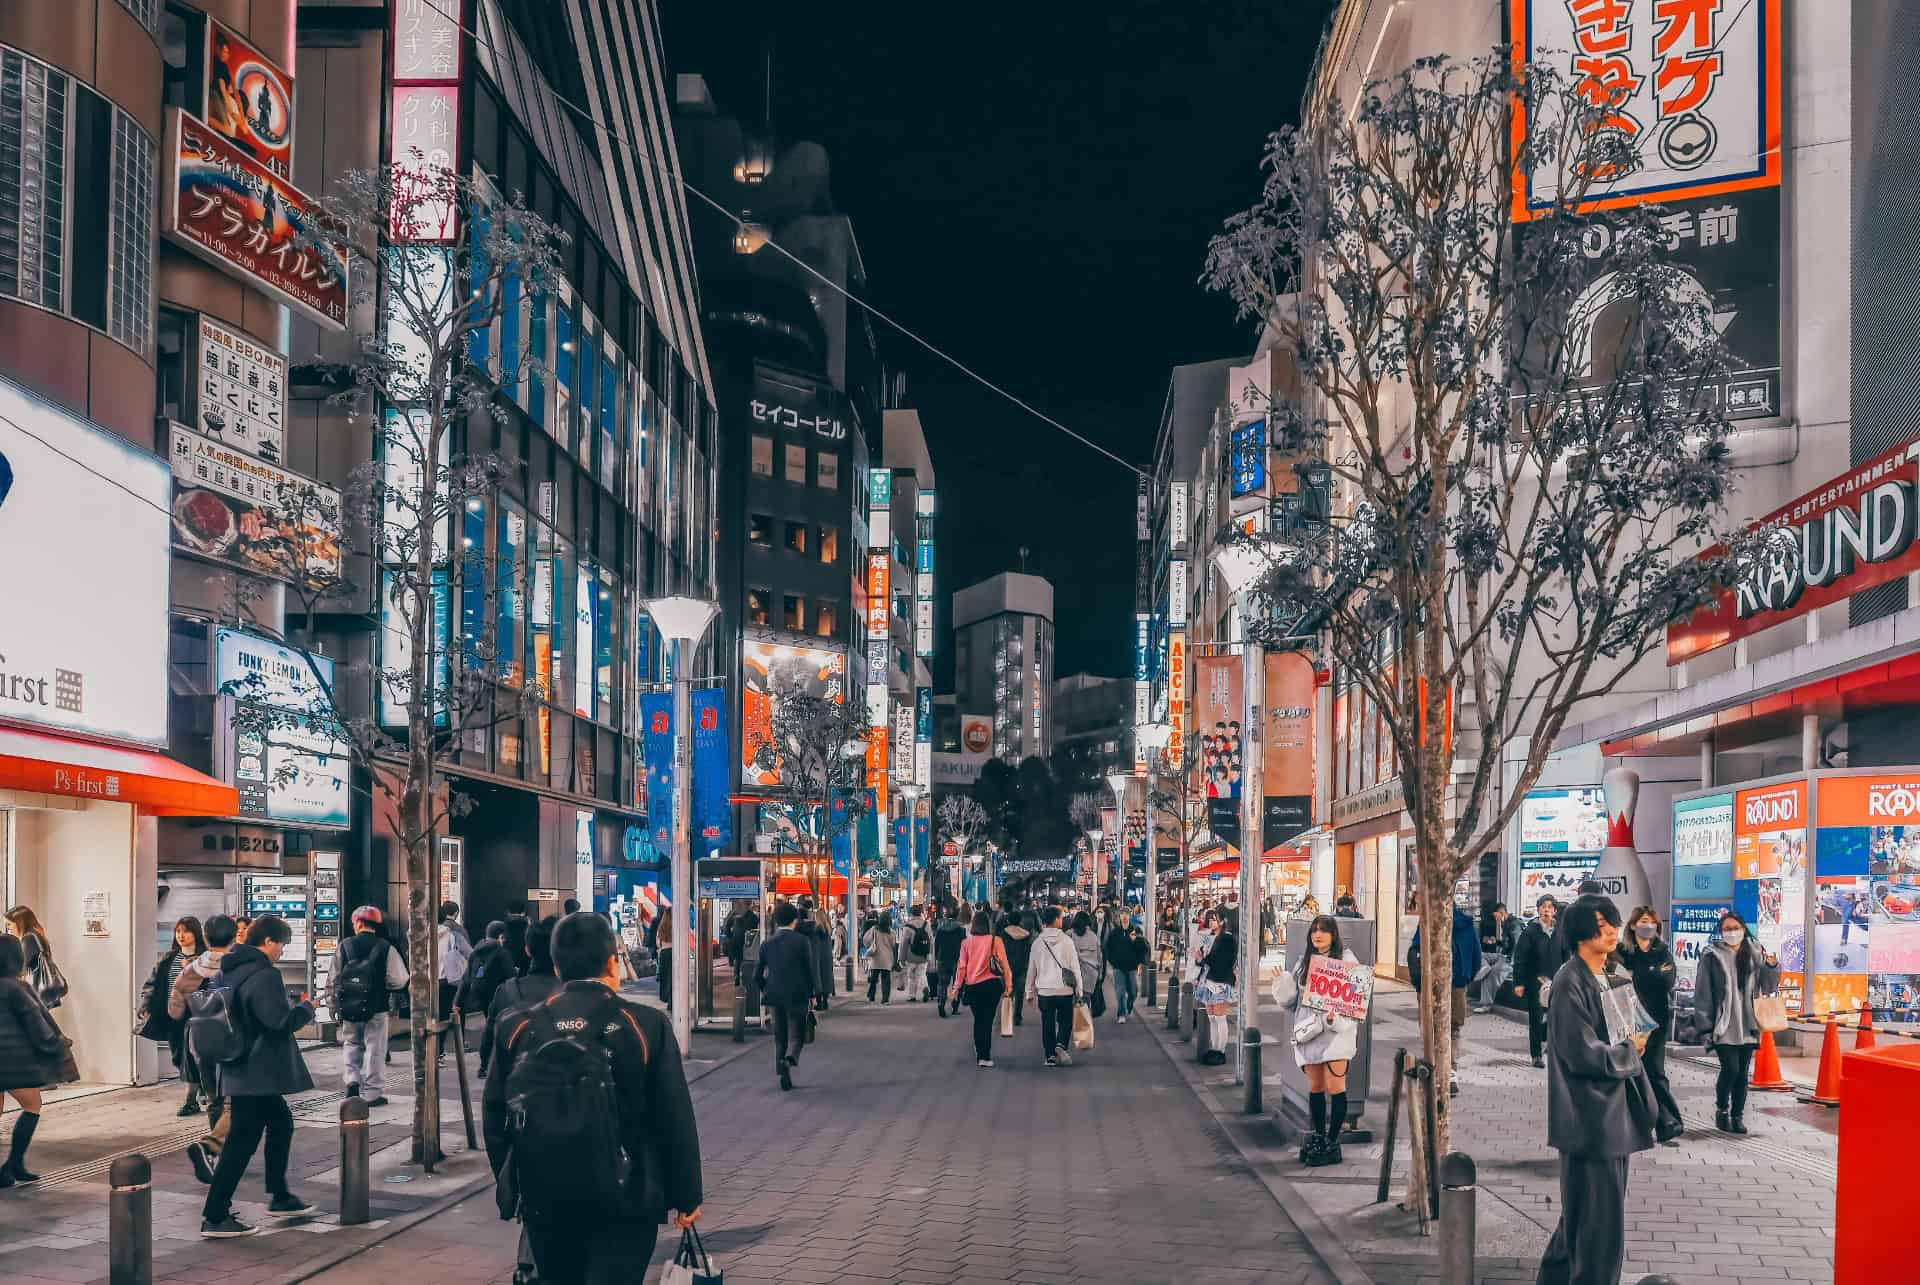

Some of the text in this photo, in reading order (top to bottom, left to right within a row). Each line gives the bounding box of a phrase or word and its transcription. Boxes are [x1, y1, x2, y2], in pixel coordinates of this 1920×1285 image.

[326, 301, 344, 319] 4F
[206, 350, 279, 397] 暗証番号
[206, 380, 279, 425] にくにく
[750, 399, 846, 439] セイコービル
[238, 651, 269, 673] FUNKY
[272, 660, 300, 681] LEMON
